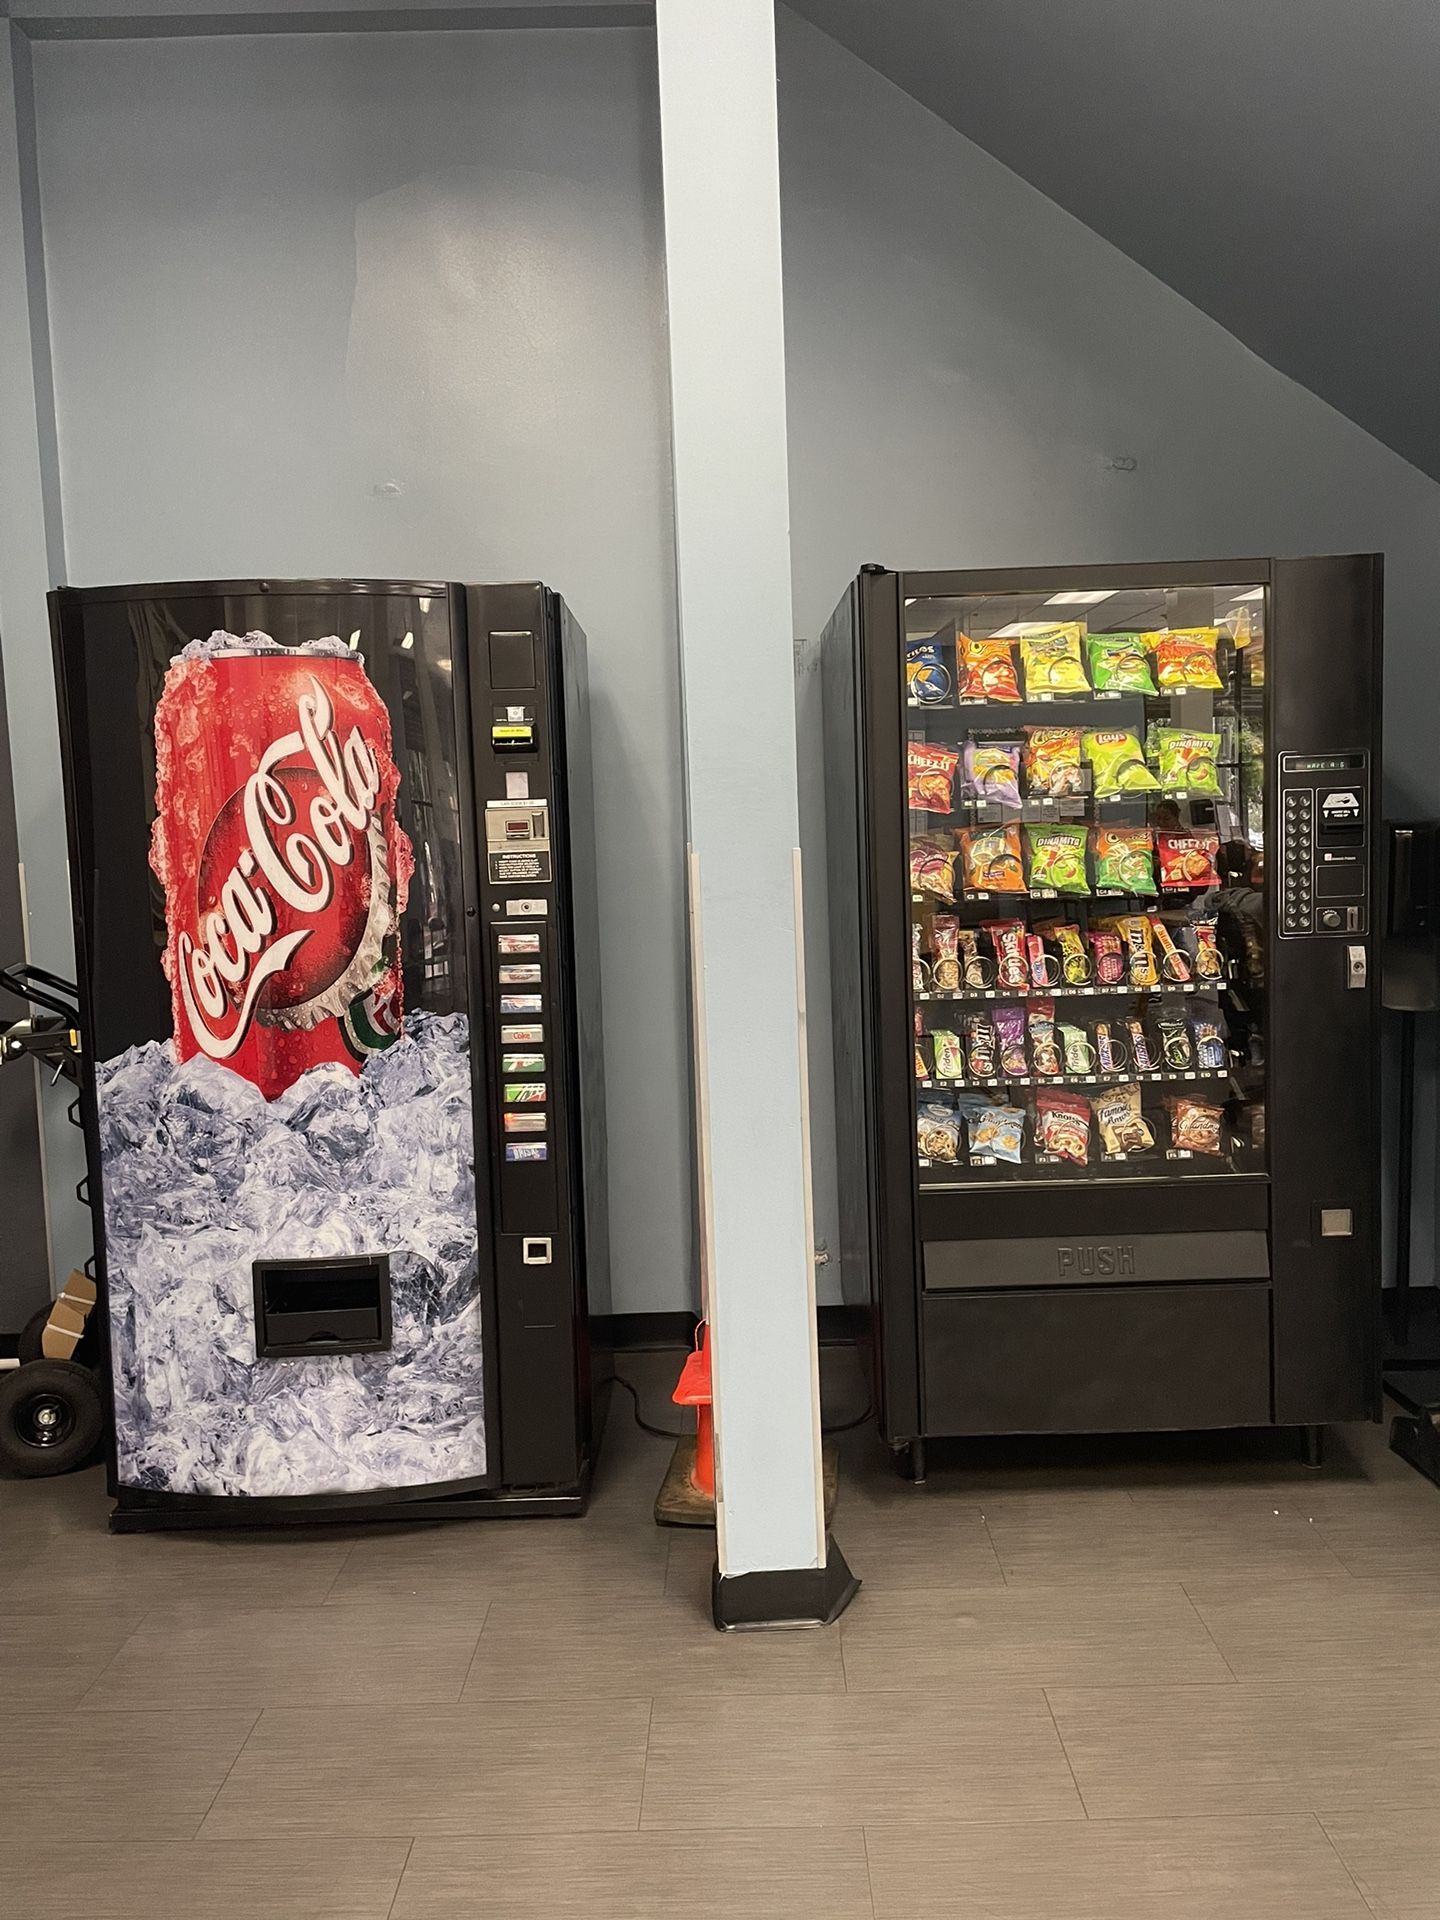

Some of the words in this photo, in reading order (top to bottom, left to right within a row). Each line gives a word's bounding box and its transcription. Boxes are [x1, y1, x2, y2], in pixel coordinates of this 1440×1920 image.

[178, 674, 380, 1058] Coca-Cola
[513, 1032, 531, 1040] Coke
[943, 1044, 951, 1073] Triden
[1057, 1246, 1136, 1277] PUSH
